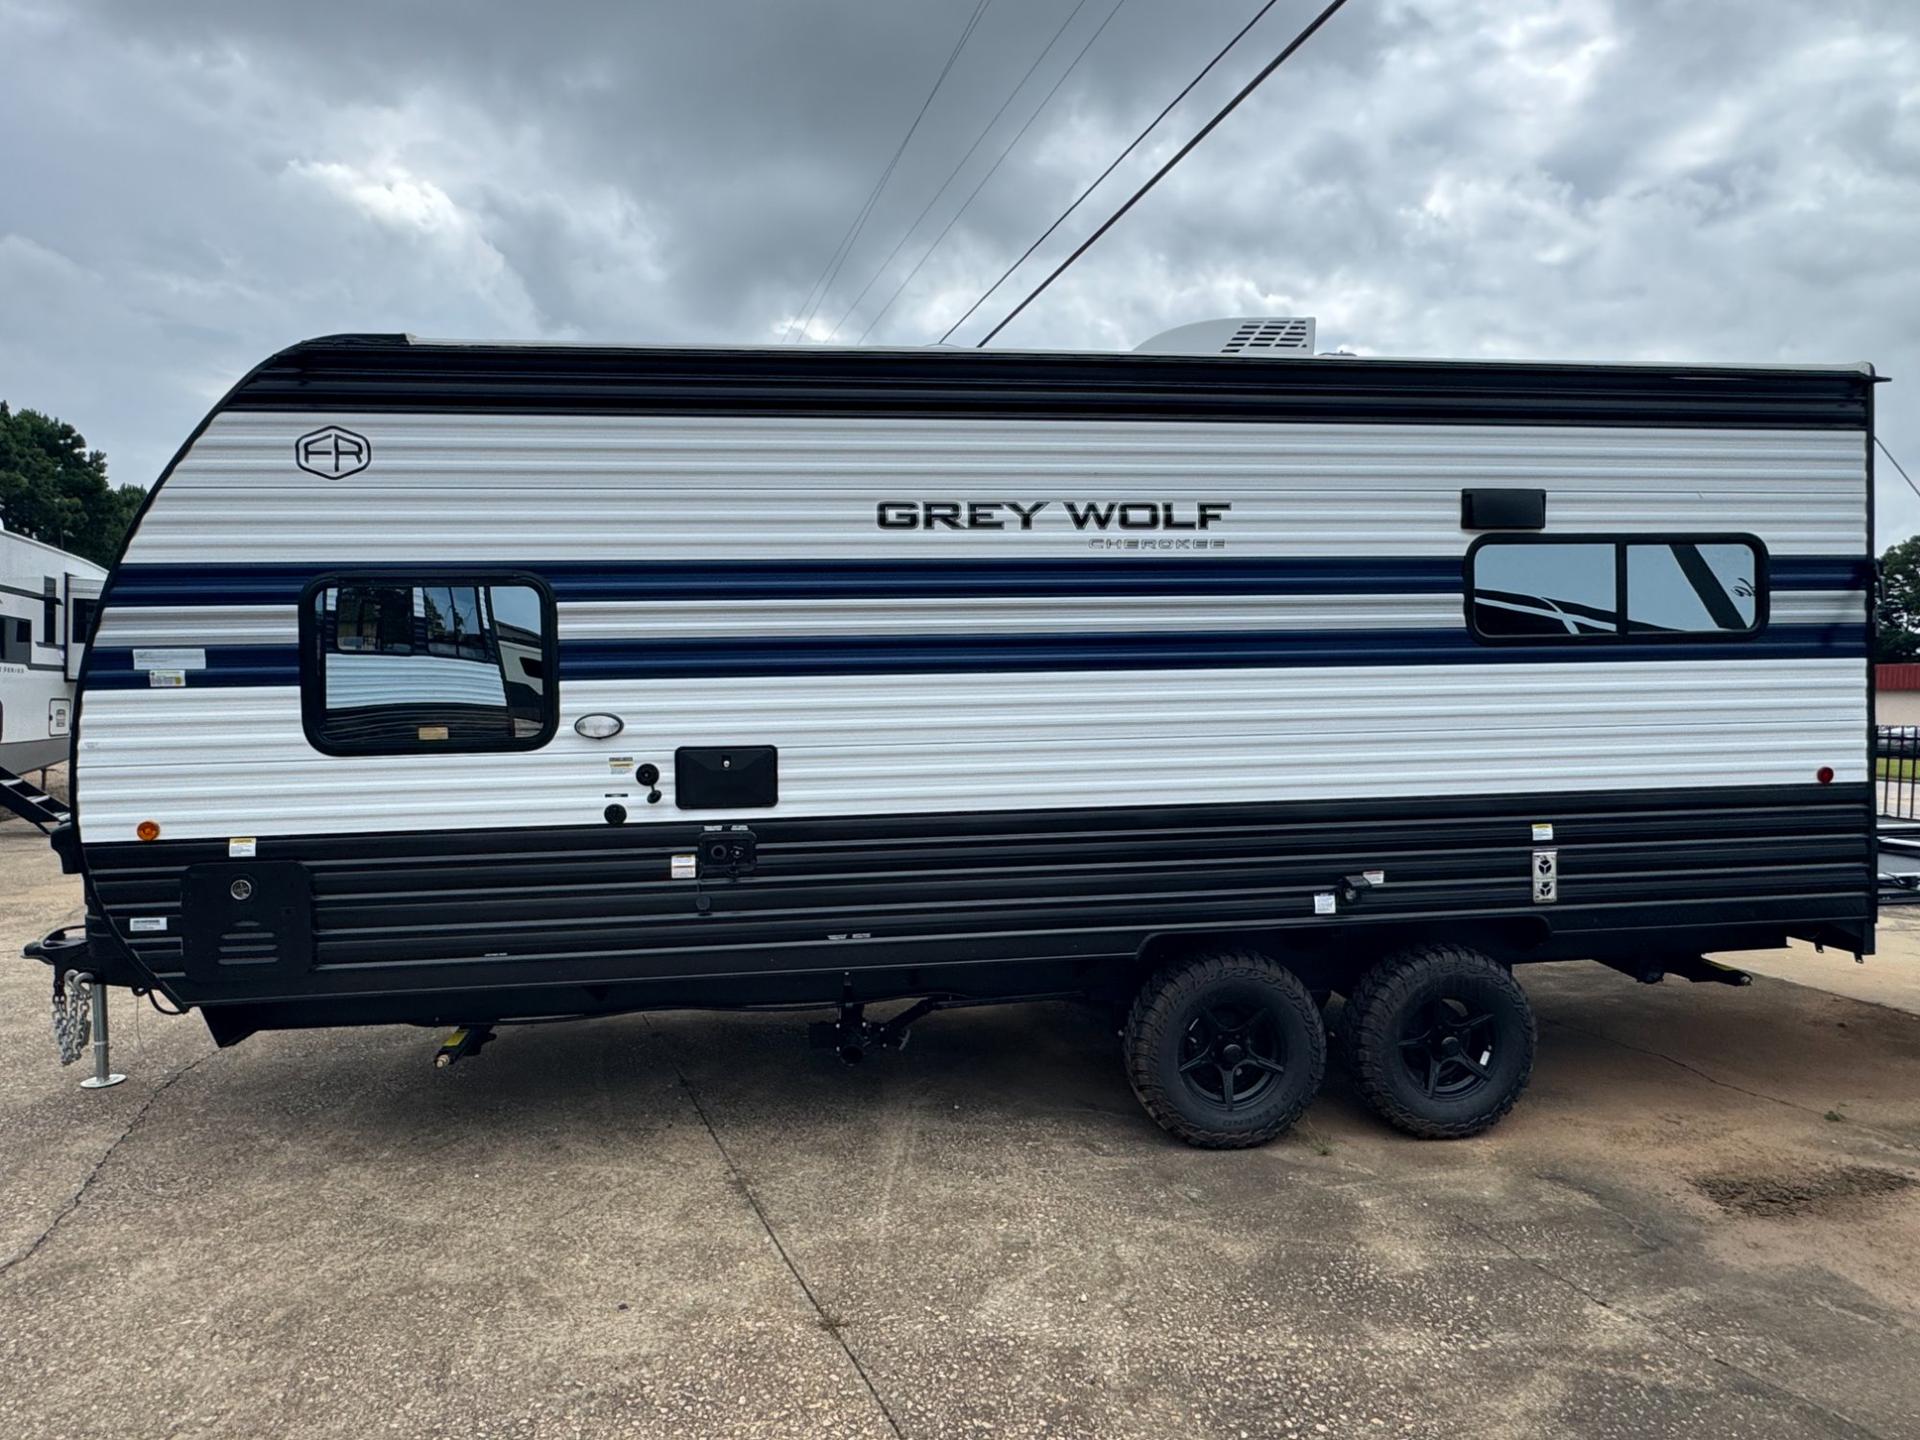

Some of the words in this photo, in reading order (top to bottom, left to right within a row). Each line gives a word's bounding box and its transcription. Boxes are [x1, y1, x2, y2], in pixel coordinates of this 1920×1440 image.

[877, 501, 1050, 531] GREY
[1063, 501, 1232, 531] WOLF
[1088, 538, 1226, 550] CHEROKEE
